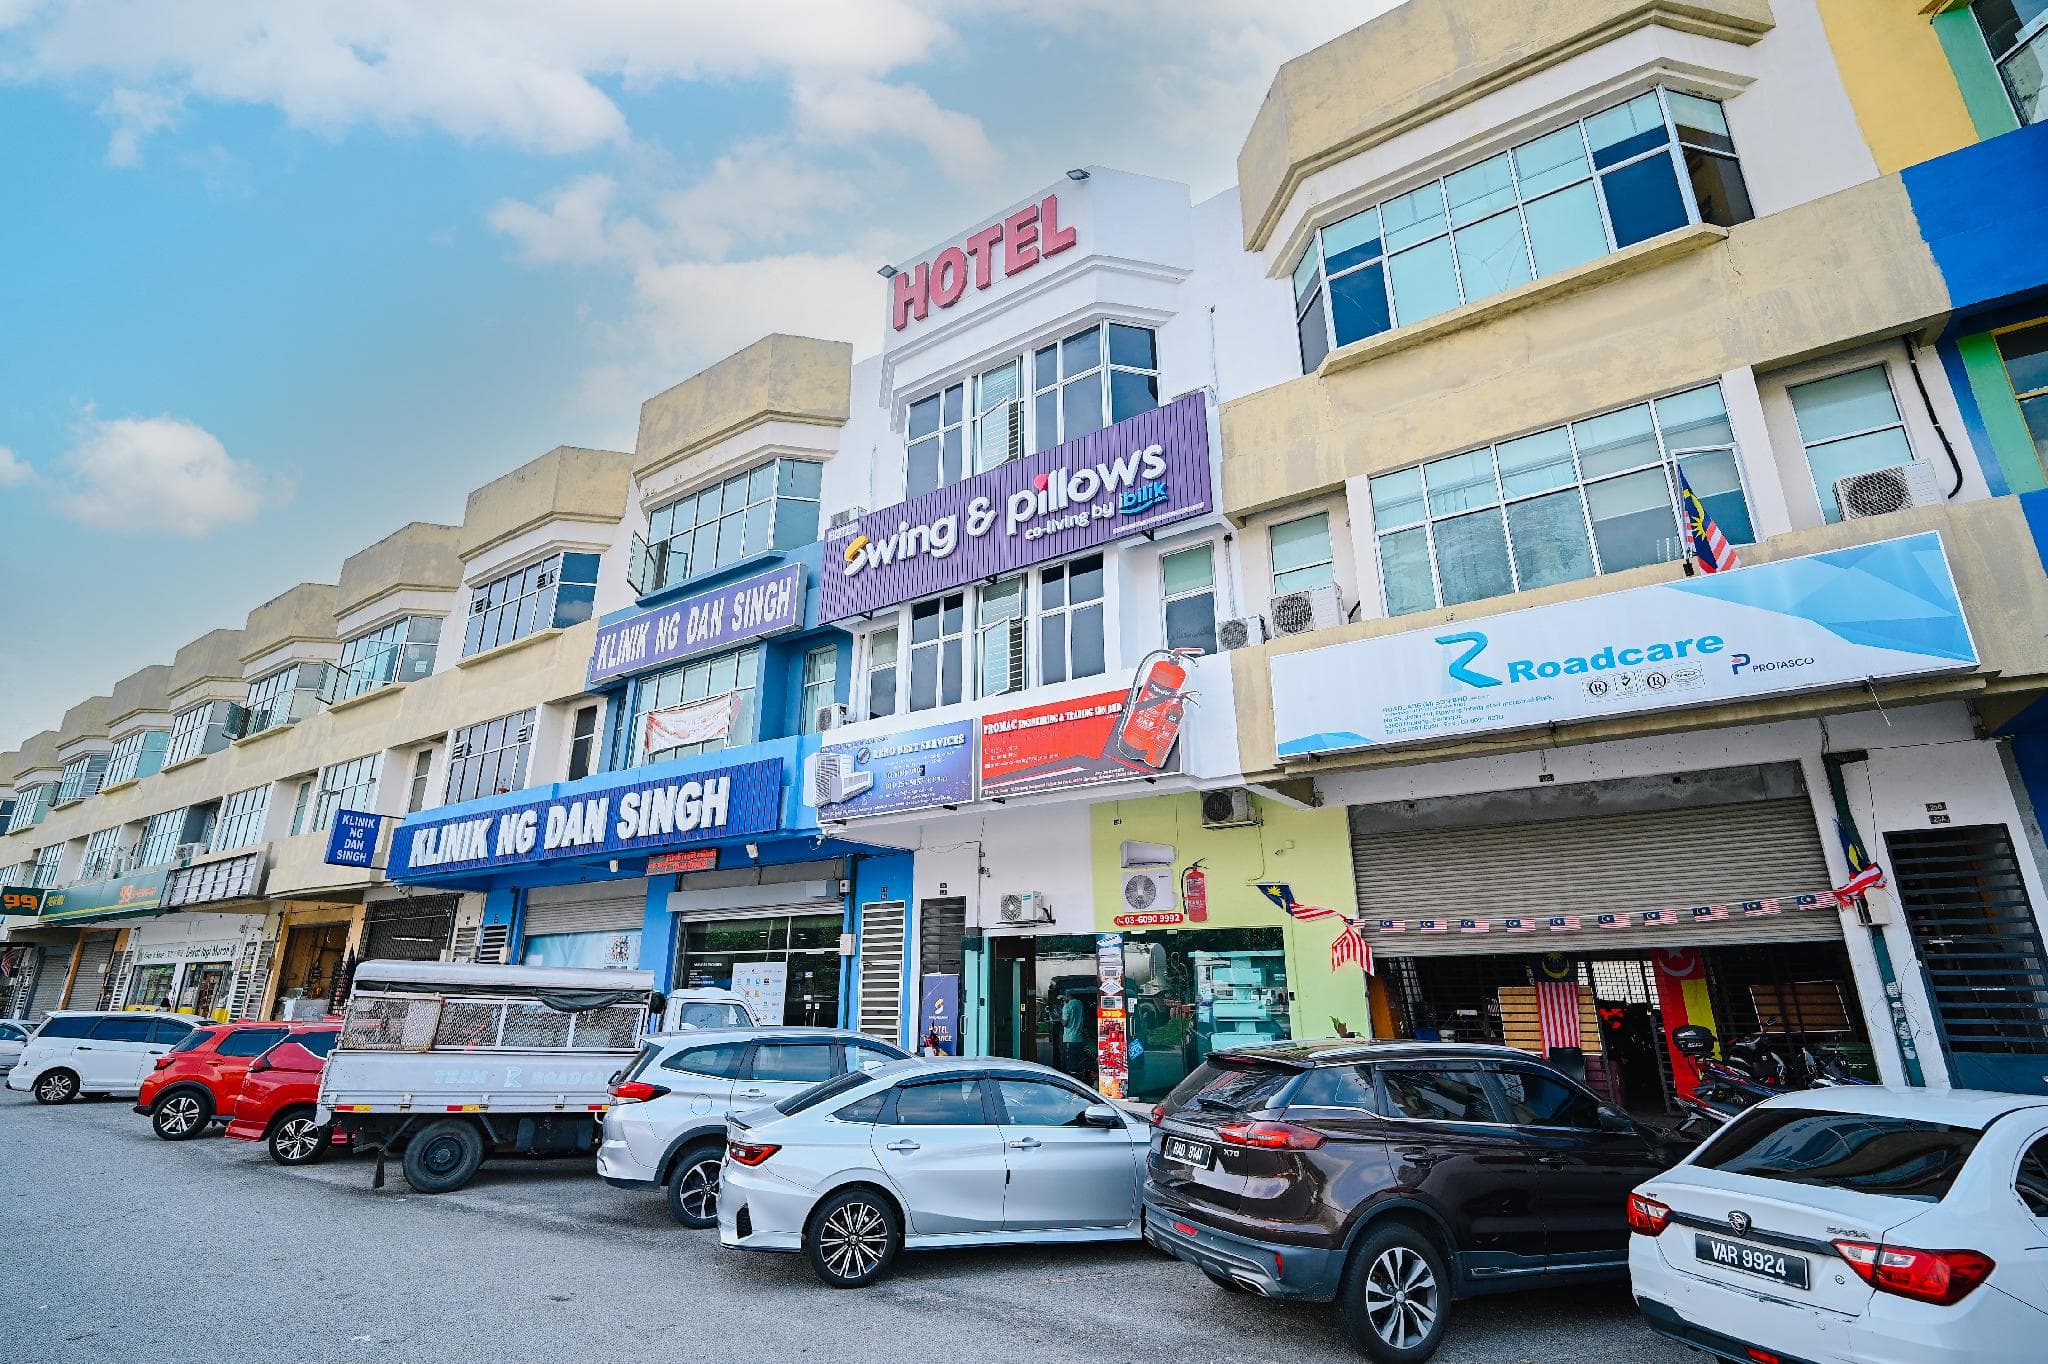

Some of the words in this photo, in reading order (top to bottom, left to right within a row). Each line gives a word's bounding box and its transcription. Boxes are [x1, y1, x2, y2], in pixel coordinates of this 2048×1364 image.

[893, 194, 1077, 331] HOTEL
[843, 512, 958, 577] Swing
[966, 496, 998, 537] &
[1006, 443, 1167, 536] pillows
[1025, 511, 1091, 541] co-living
[1091, 501, 1115, 520] by
[596, 622, 650, 671] KLINIK
[655, 610, 681, 655] NG
[686, 596, 726, 645] DAN
[731, 576, 792, 632] SINGH
[1508, 634, 1725, 684] Roadcare
[1752, 657, 1815, 673] PROTASCO
[983, 719, 1017, 736] PROMAC
[1058, 712, 1066, 723] &
[341, 814, 376, 829] KLINIK
[408, 816, 493, 869] KLINIK
[495, 810, 538, 857] NG
[543, 797, 609, 851] DAN
[616, 776, 730, 840] SINGH
[349, 827, 364, 839] NG
[344, 838, 365, 851] DAN
[336, 849, 367, 863] SINGH
[3, 894, 37, 910] 99
[1124, 914, 1158, 925] 03-6090
[1159, 913, 1180, 923] 9992
[434, 1070, 489, 1085] TEAM
[531, 1070, 609, 1086] ROADCA
[1223, 1148, 1240, 1157] X70
[1710, 1240, 1738, 1265] VAR
[1743, 1249, 1787, 1277] 9924
